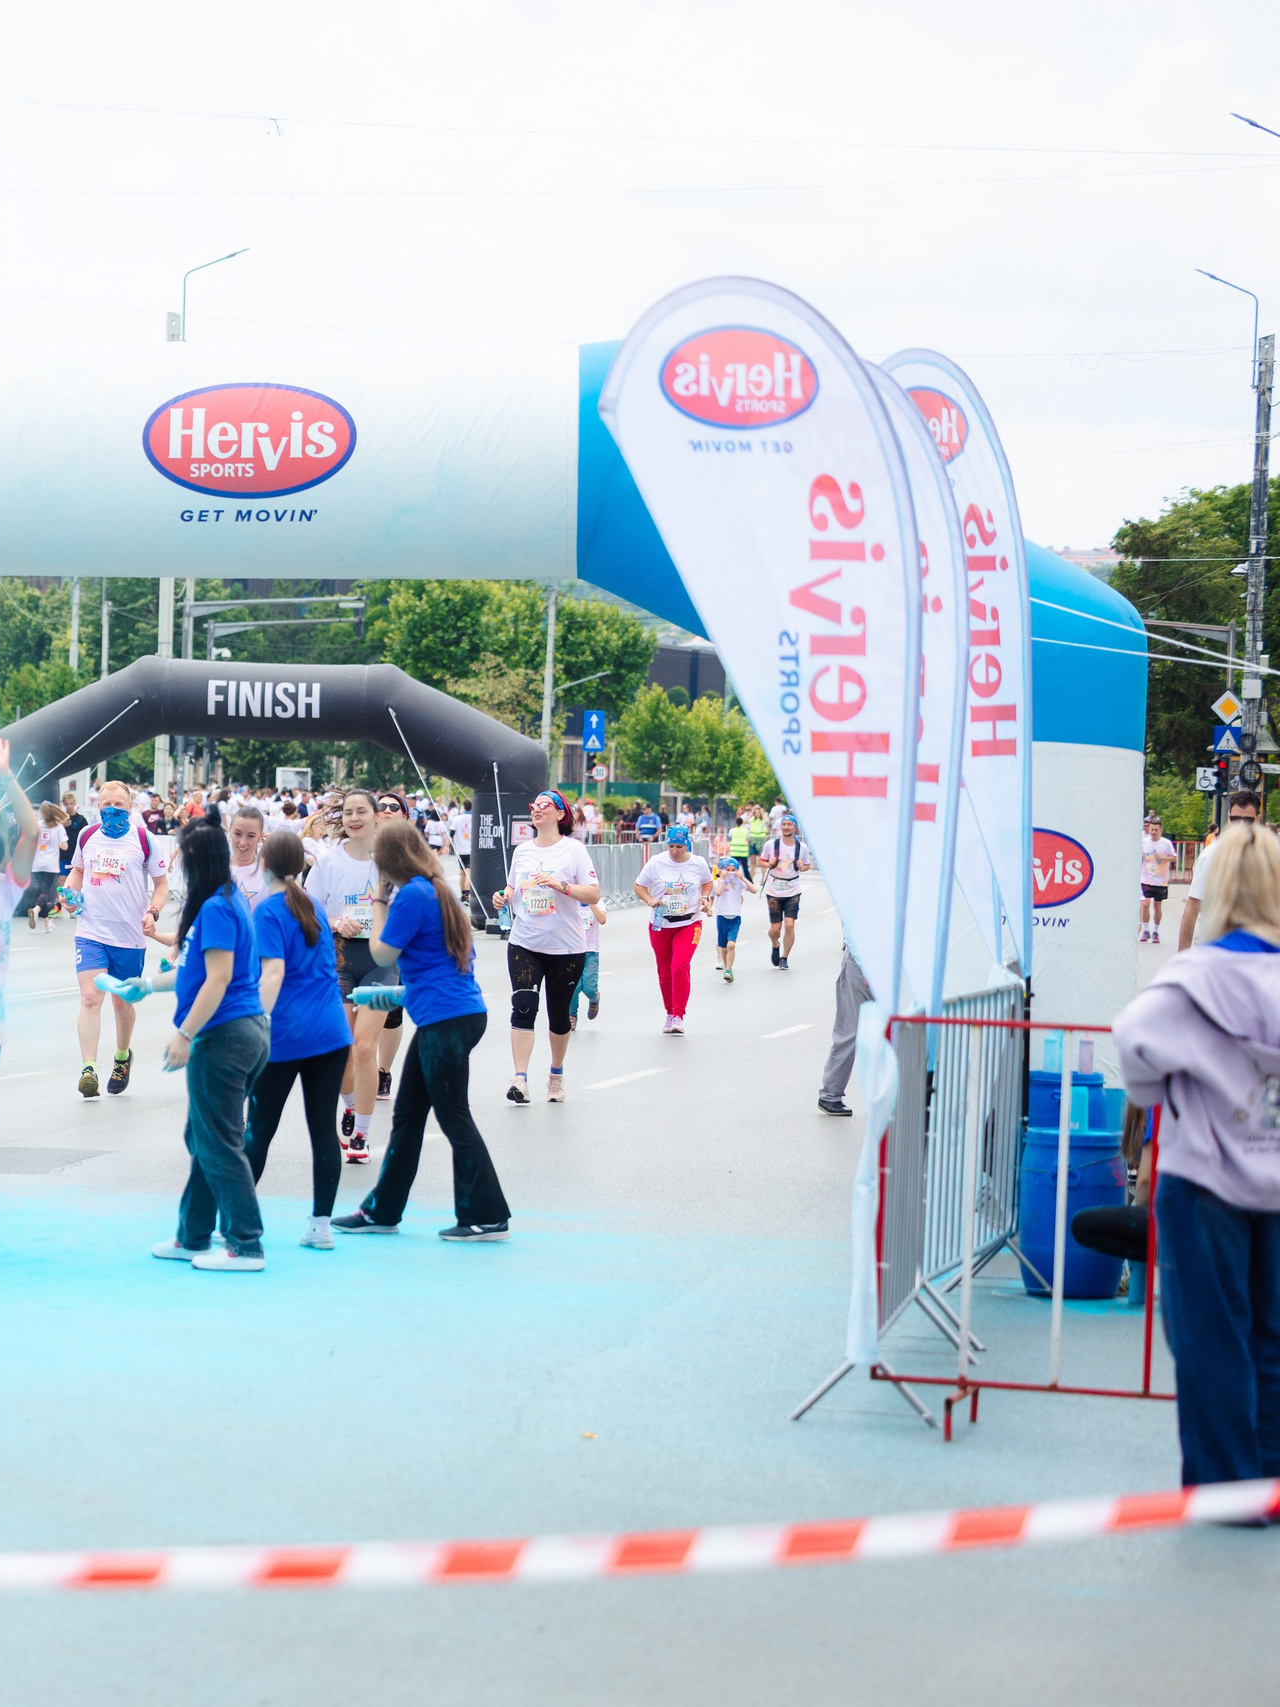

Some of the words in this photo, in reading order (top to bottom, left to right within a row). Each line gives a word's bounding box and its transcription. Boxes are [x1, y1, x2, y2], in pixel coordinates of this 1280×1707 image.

[168, 407, 337, 471] Hervis
[190, 463, 254, 478] SPORTS
[180, 510, 224, 523] GET
[235, 509, 318, 523] MOVIN'
[207, 679, 321, 719] FINISH
[594, 768, 605, 777] 30
[480, 814, 493, 826] THE
[479, 826, 505, 838] COLOR
[479, 838, 496, 849] RUN.
[102, 858, 119, 868] 15425
[1033, 851, 1084, 891] vis
[344, 895, 358, 905] THE
[531, 899, 547, 908] 17227
[1032, 917, 1069, 928] OVIN'
